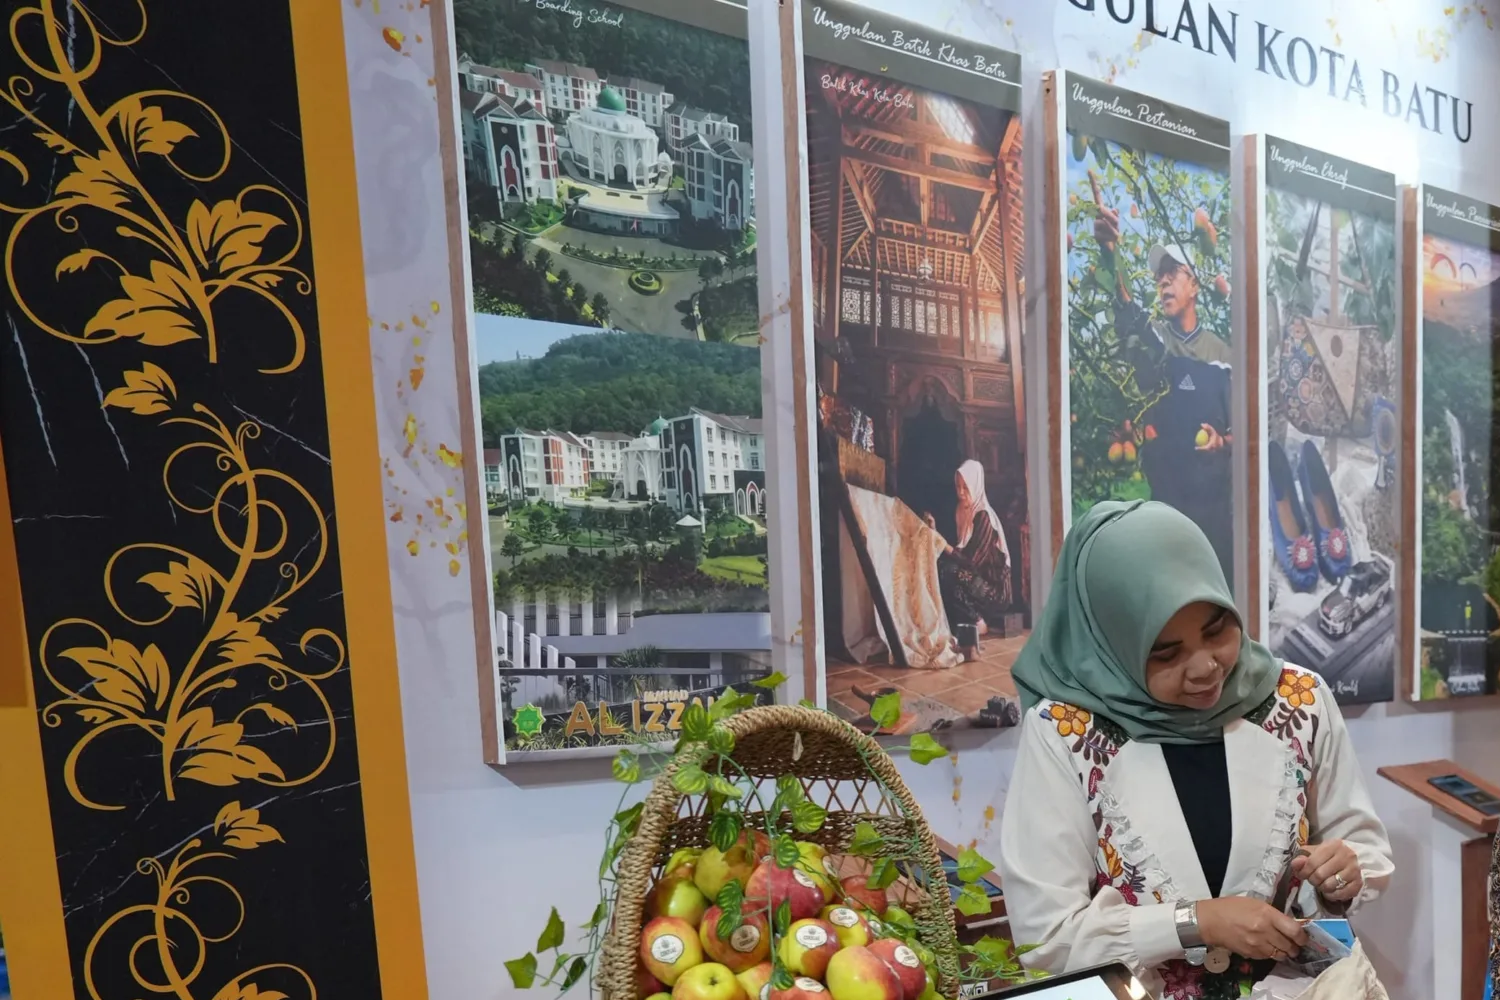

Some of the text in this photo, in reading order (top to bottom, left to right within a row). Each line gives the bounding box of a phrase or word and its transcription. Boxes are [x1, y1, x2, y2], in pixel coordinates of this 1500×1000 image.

[535, 0, 623, 28] Boarding School
[813, 6, 1008, 79] Unggulan Batik Khas Batu
[1067, 0, 1473, 143] LAN KOTA BATU
[1072, 82, 1198, 137] Unggulan Pertanian
[1270, 144, 1319, 173] Unggulan
[1425, 193, 1466, 218] Unggulan
[565, 695, 715, 736] AL IZZ
